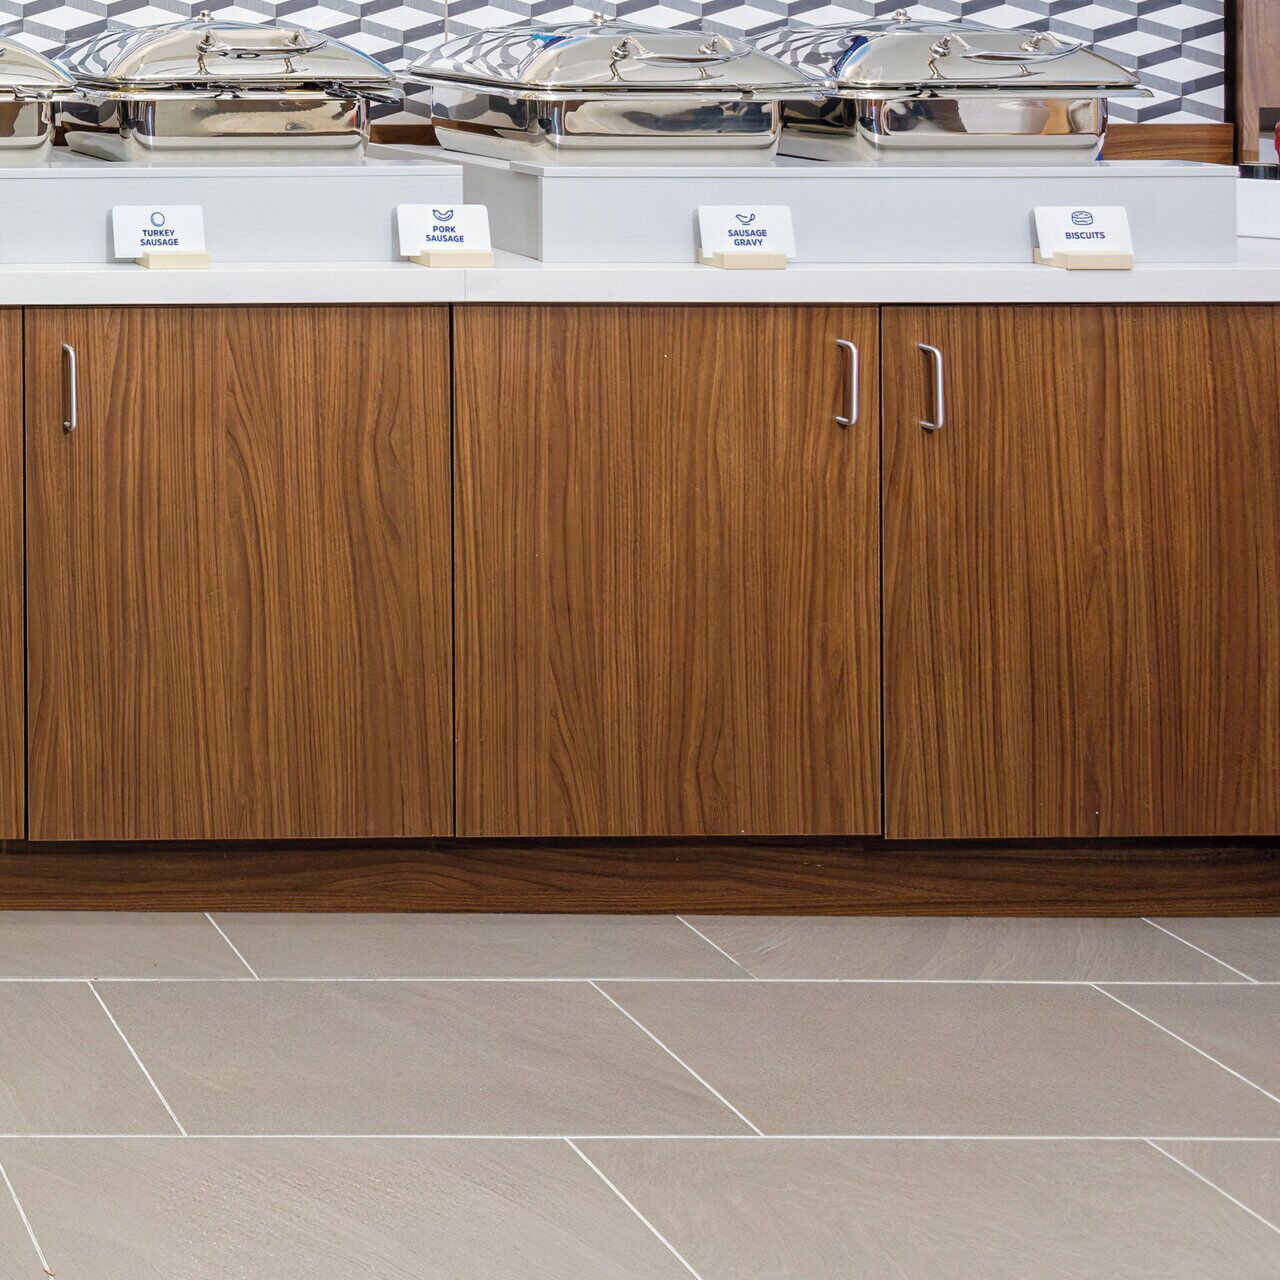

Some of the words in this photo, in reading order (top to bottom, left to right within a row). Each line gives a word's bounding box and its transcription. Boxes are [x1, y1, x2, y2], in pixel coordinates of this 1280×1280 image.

[142, 229, 175, 237] TURKEY
[432, 225, 456, 233] PORK
[727, 229, 768, 237] SAUSAGE
[425, 234, 465, 243] SAUSAGE
[1065, 231, 1106, 240] BISCUITS
[140, 238, 179, 247] SAUSAGE
[733, 238, 763, 247] GRAVY
